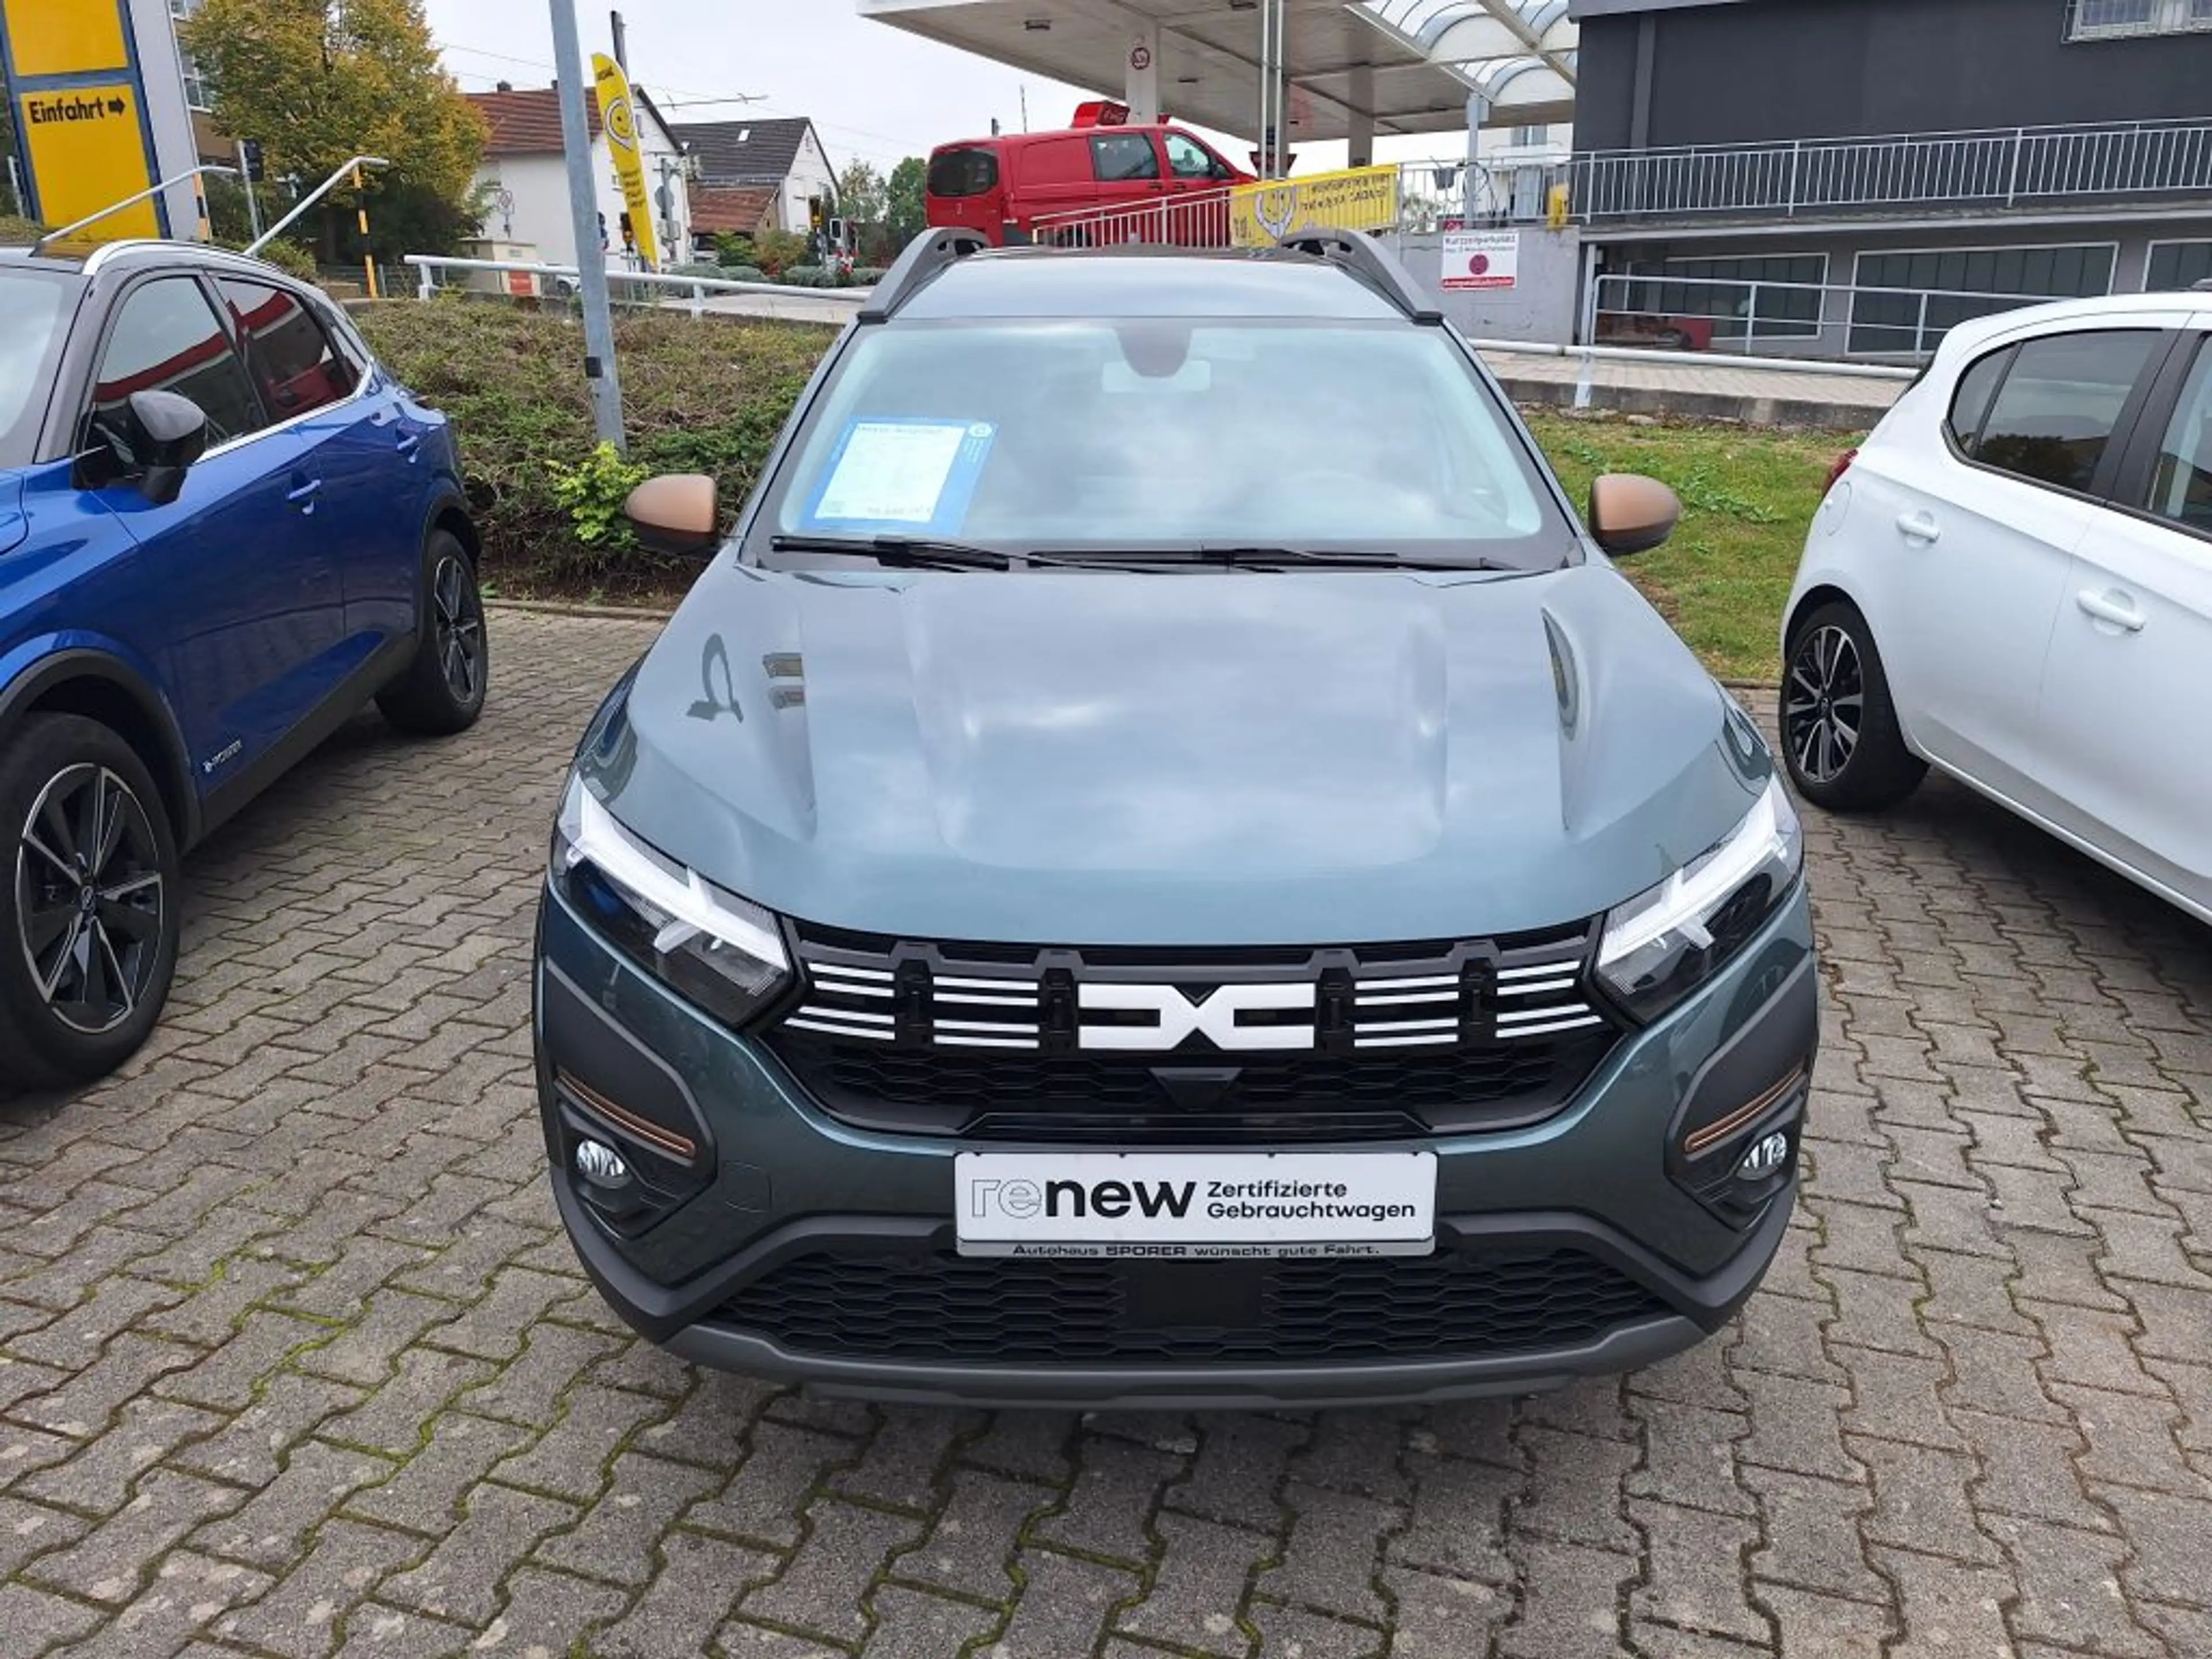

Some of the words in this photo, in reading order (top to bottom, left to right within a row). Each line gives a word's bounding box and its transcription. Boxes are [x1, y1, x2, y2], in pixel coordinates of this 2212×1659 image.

[28, 96, 105, 124] Einfahrt
[972, 1179, 1197, 1218] renew
[1207, 1180, 1347, 1198] Zertifizierte
[1207, 1202, 1415, 1221] Gebrauchtwagen
[1013, 1244, 1099, 1256] Autohaus
[1105, 1245, 1187, 1256] SPORER
[1194, 1245, 1271, 1256] wünscht
[1278, 1246, 1317, 1258] gute
[1324, 1244, 1380, 1255] Fahrt.
